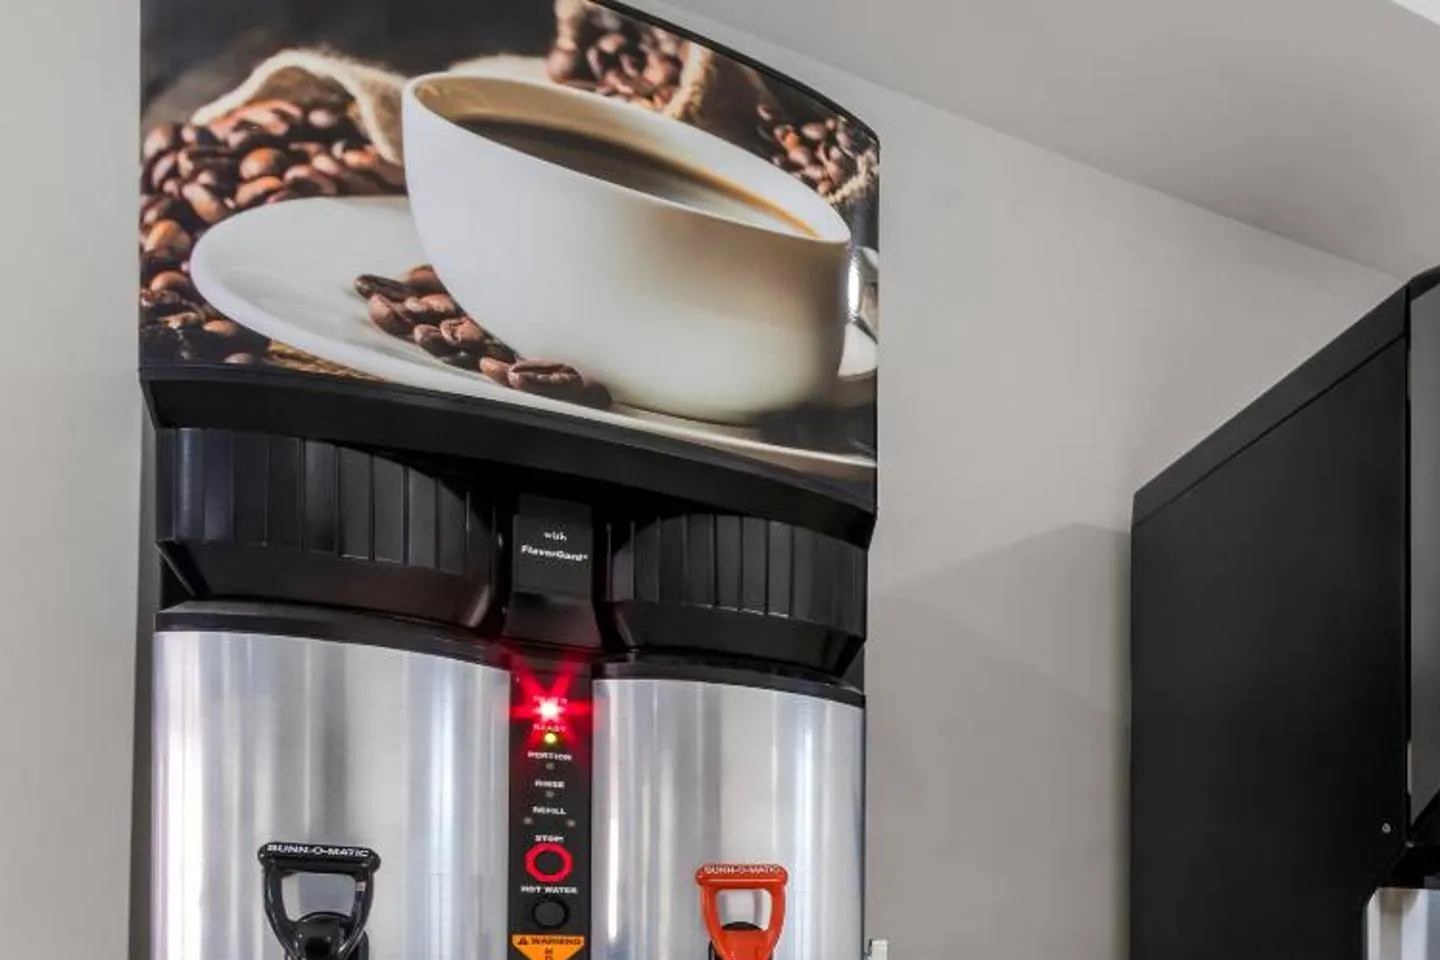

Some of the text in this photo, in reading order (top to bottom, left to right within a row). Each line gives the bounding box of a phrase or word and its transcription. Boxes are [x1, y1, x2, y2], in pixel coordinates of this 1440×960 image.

[544, 531, 568, 541] with
[520, 885, 579, 894] HOT WATER
[531, 936, 582, 945] WARNING
